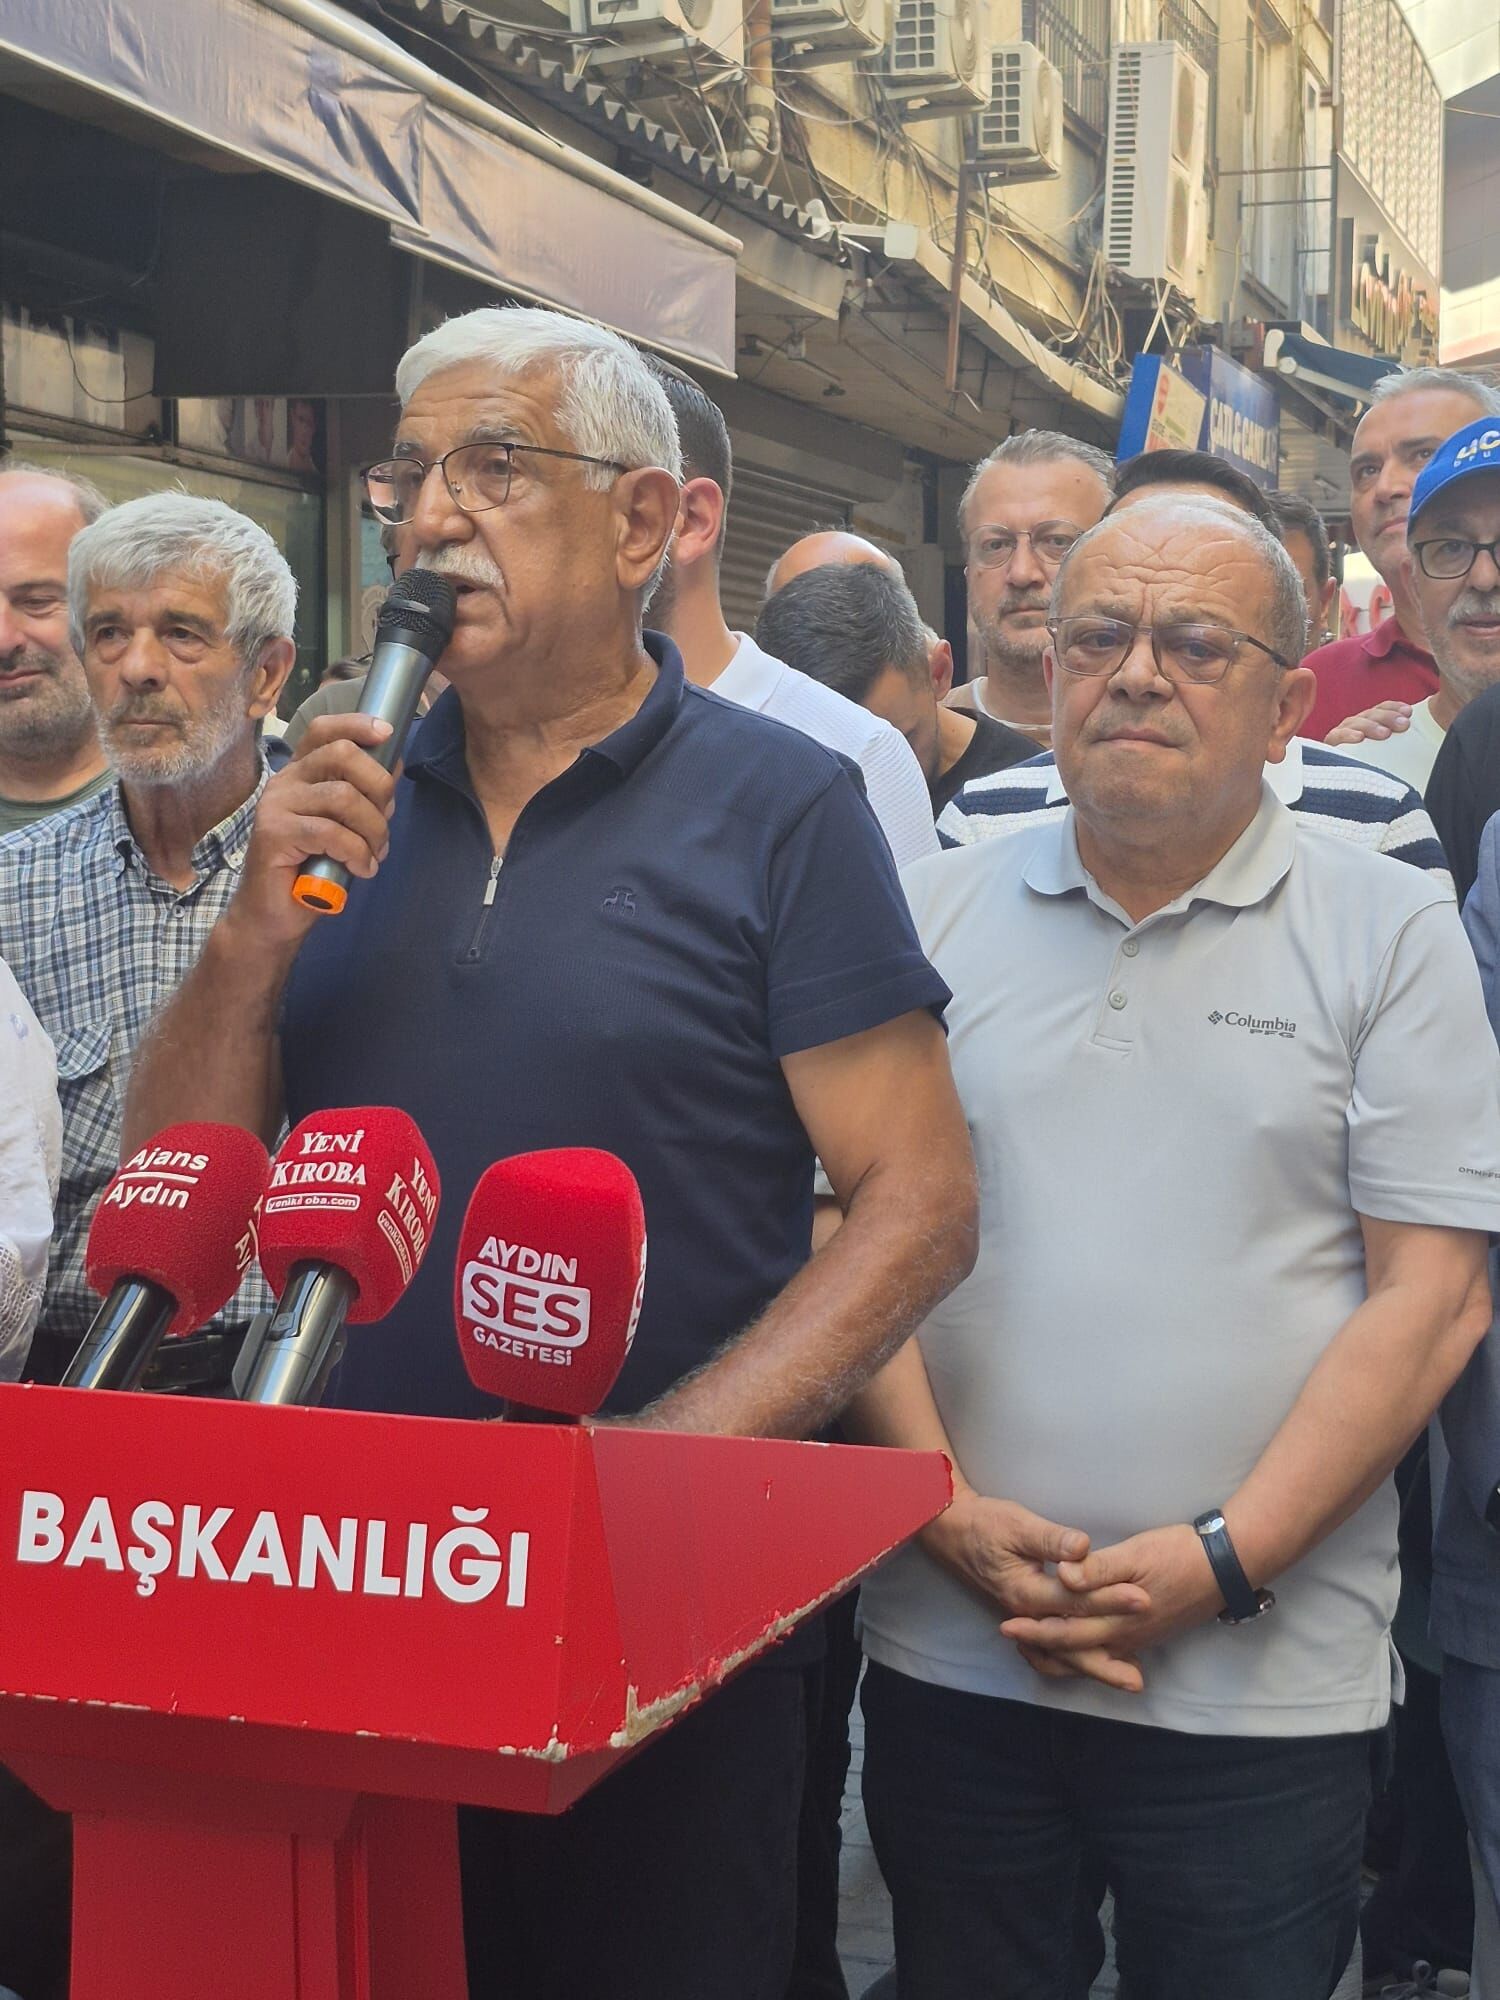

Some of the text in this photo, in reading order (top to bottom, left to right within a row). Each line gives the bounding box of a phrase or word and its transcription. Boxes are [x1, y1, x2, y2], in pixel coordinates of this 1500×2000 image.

[1224, 1011, 1297, 1033] Columbia
[125, 1147, 209, 1171] Ajans
[268, 1160, 367, 1189] KIROBA
[104, 1181, 190, 1209] Aydın
[477, 1235, 578, 1284] AYDIN
[470, 1272, 582, 1338] SES
[17, 1490, 529, 1607] BAŞKANLIĞI
